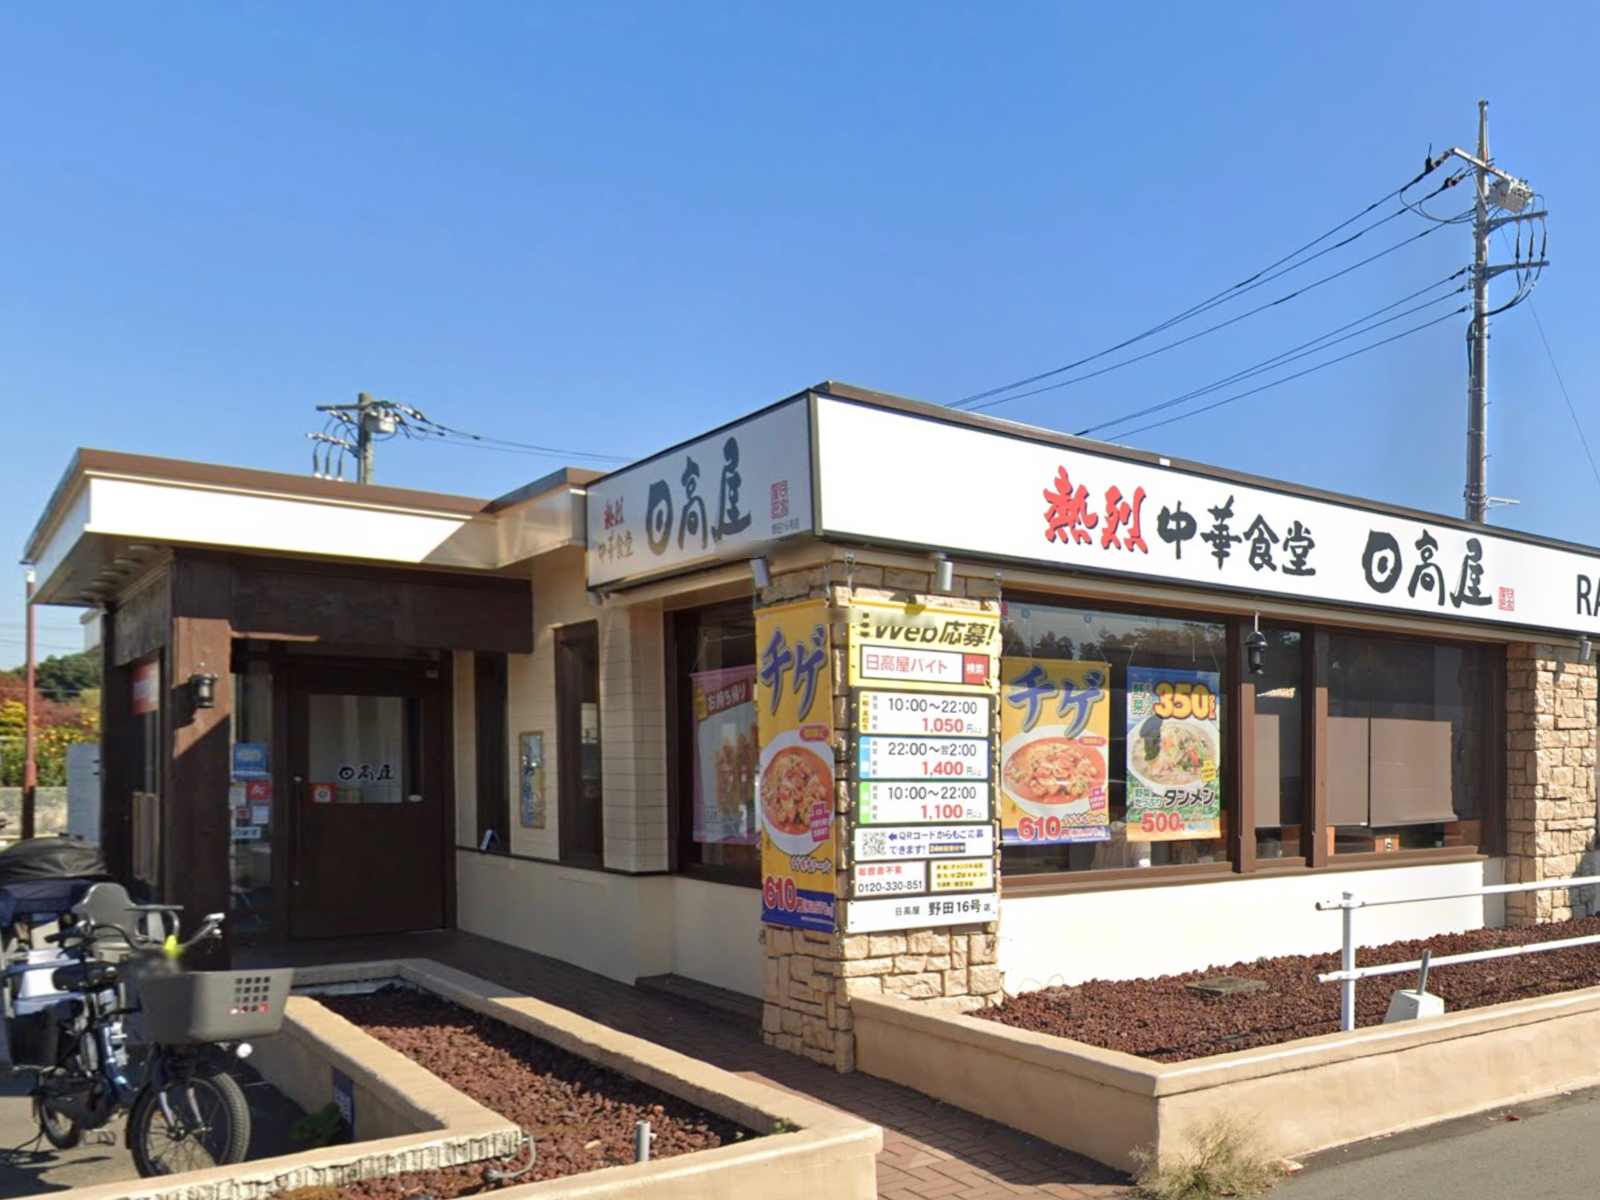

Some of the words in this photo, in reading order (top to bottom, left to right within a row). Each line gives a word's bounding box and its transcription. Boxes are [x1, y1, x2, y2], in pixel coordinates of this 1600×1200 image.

[646, 436, 752, 556] 日高屋
[1043, 465, 1148, 554] 熱烈
[1156, 494, 1316, 576] 中華食堂
[1362, 529, 1492, 608] 日高屋
[760, 624, 828, 722] チゲ
[866, 654, 948, 675] 日高屋バイト
[966, 663, 985, 675] 検索
[1006, 664, 1106, 738] チゲ
[1154, 681, 1209, 720] 350
[921, 718, 964, 733] 1,050
[339, 764, 395, 781] 日高屋
[921, 761, 964, 776] 1,400
[1164, 788, 1215, 807] タンメン
[921, 804, 963, 820] 1,100
[898, 829, 984, 841] QRコードからもご応募
[889, 845, 926, 855] できます!
[858, 880, 922, 893] 0120-330-851
[895, 905, 920, 916] 日高屋
[928, 899, 991, 916] 野田16号店
